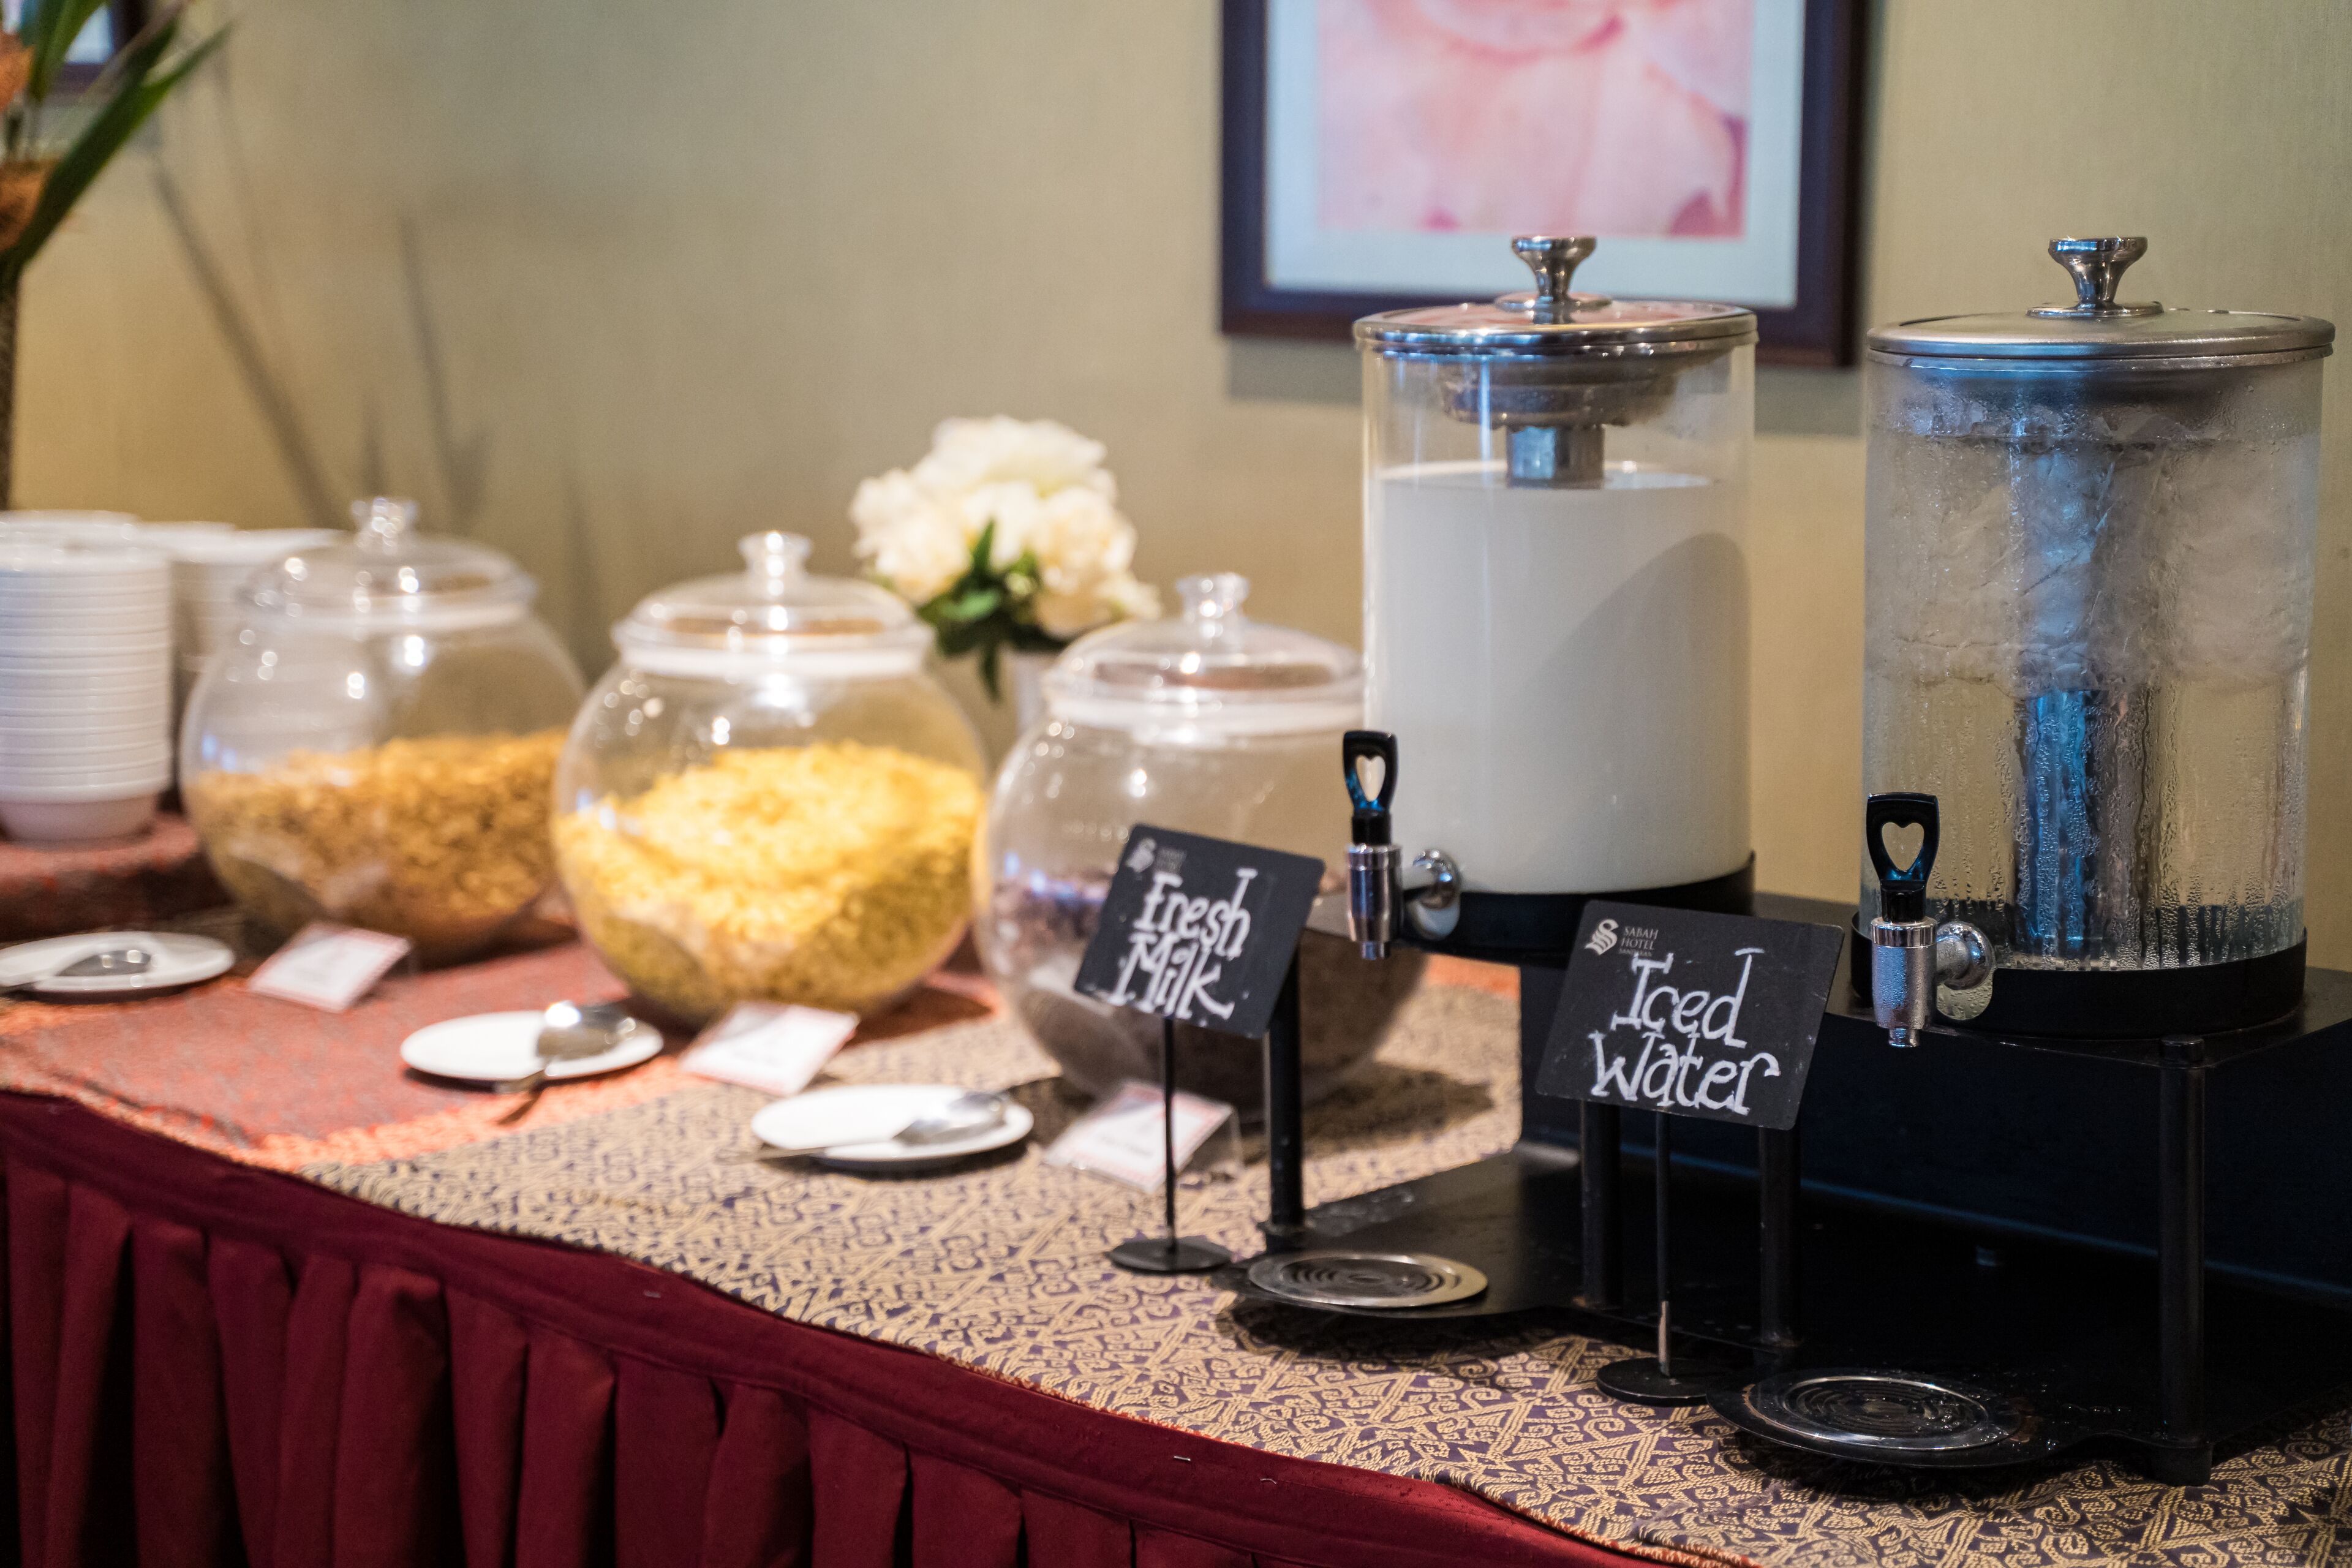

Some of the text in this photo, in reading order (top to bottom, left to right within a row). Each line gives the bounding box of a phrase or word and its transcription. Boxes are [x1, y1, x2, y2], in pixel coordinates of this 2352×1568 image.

[1133, 867, 1258, 959] Fresh
[1620, 937, 1654, 951] HOTEL
[1624, 925, 1659, 940] SABAH
[1108, 931, 1235, 1020] Milk
[1610, 948, 1765, 1048] Iced
[1588, 1030, 1781, 1115] Water
